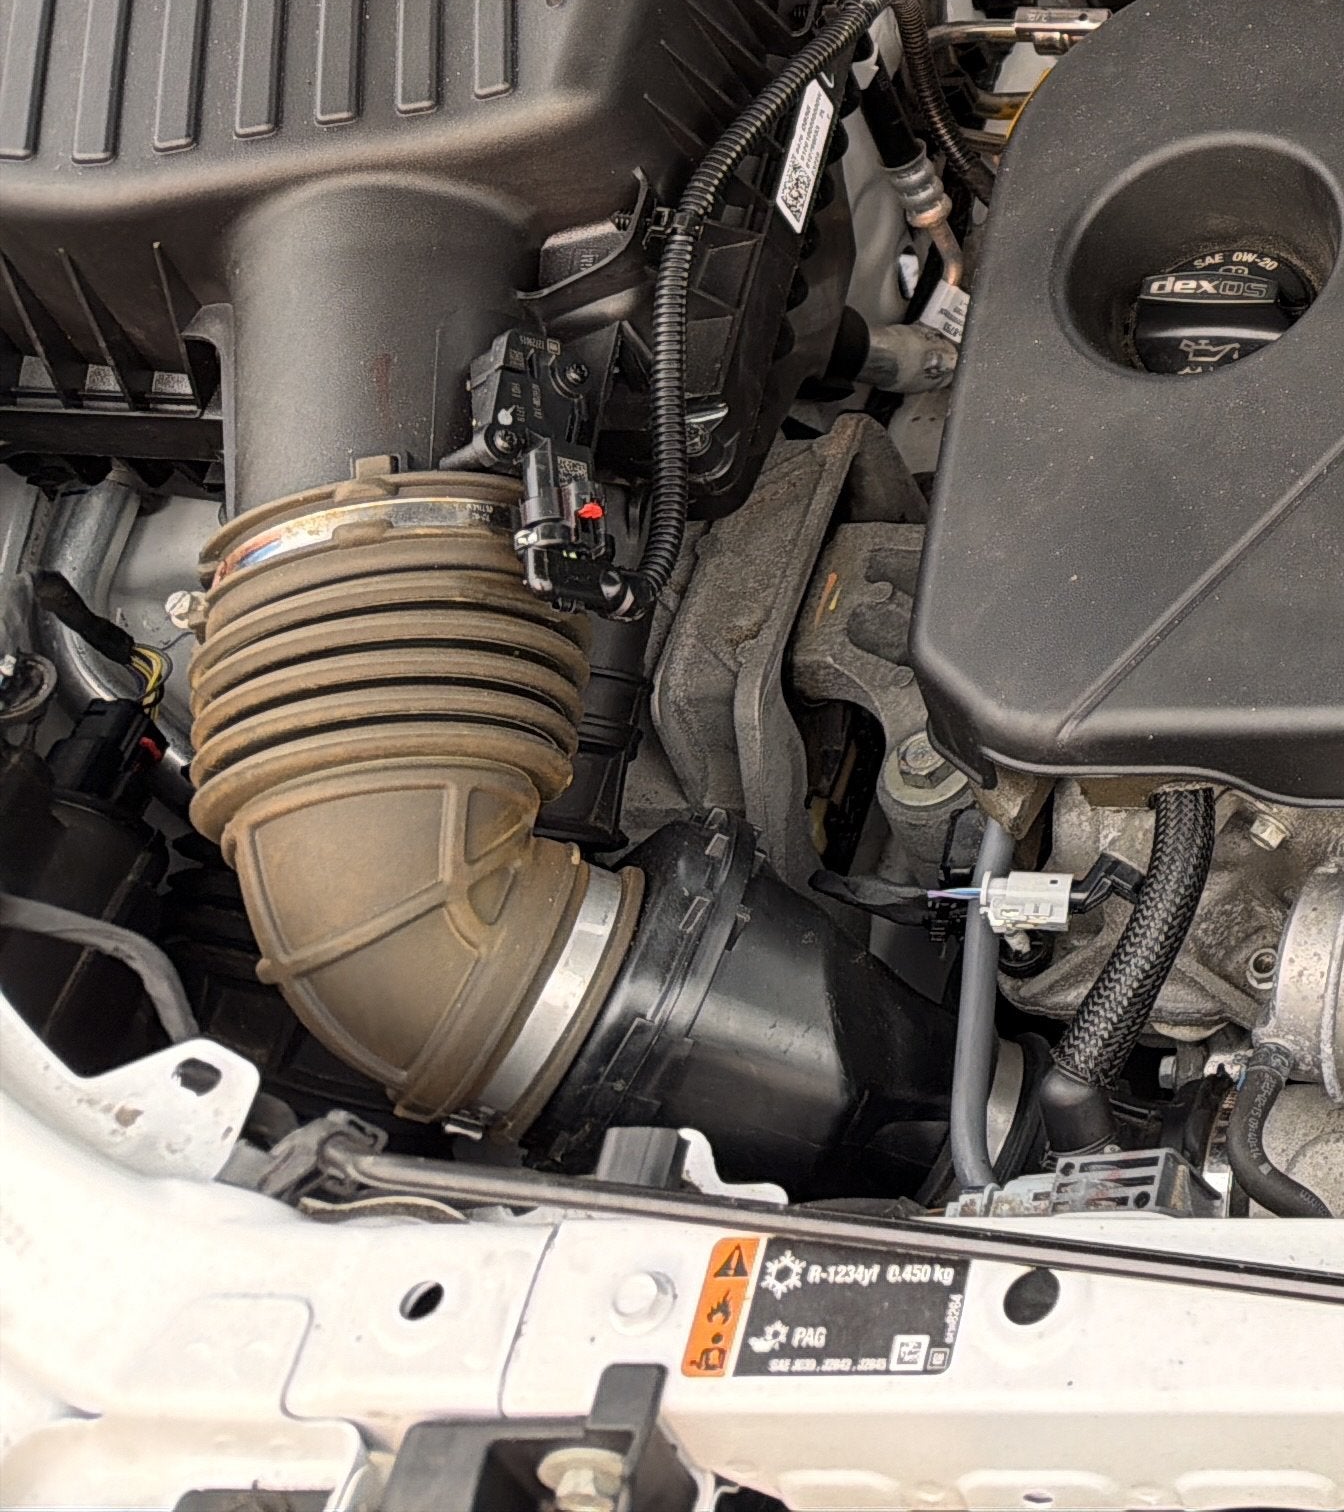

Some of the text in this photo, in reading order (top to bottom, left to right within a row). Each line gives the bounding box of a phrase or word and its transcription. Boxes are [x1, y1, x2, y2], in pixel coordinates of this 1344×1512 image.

[1194, 251, 1278, 271] SAE 0W-20
[1150, 276, 1268, 297] dexos
[806, 1264, 954, 1286] R-1234yf 0.450 kg
[791, 1327, 827, 1348] PAG
